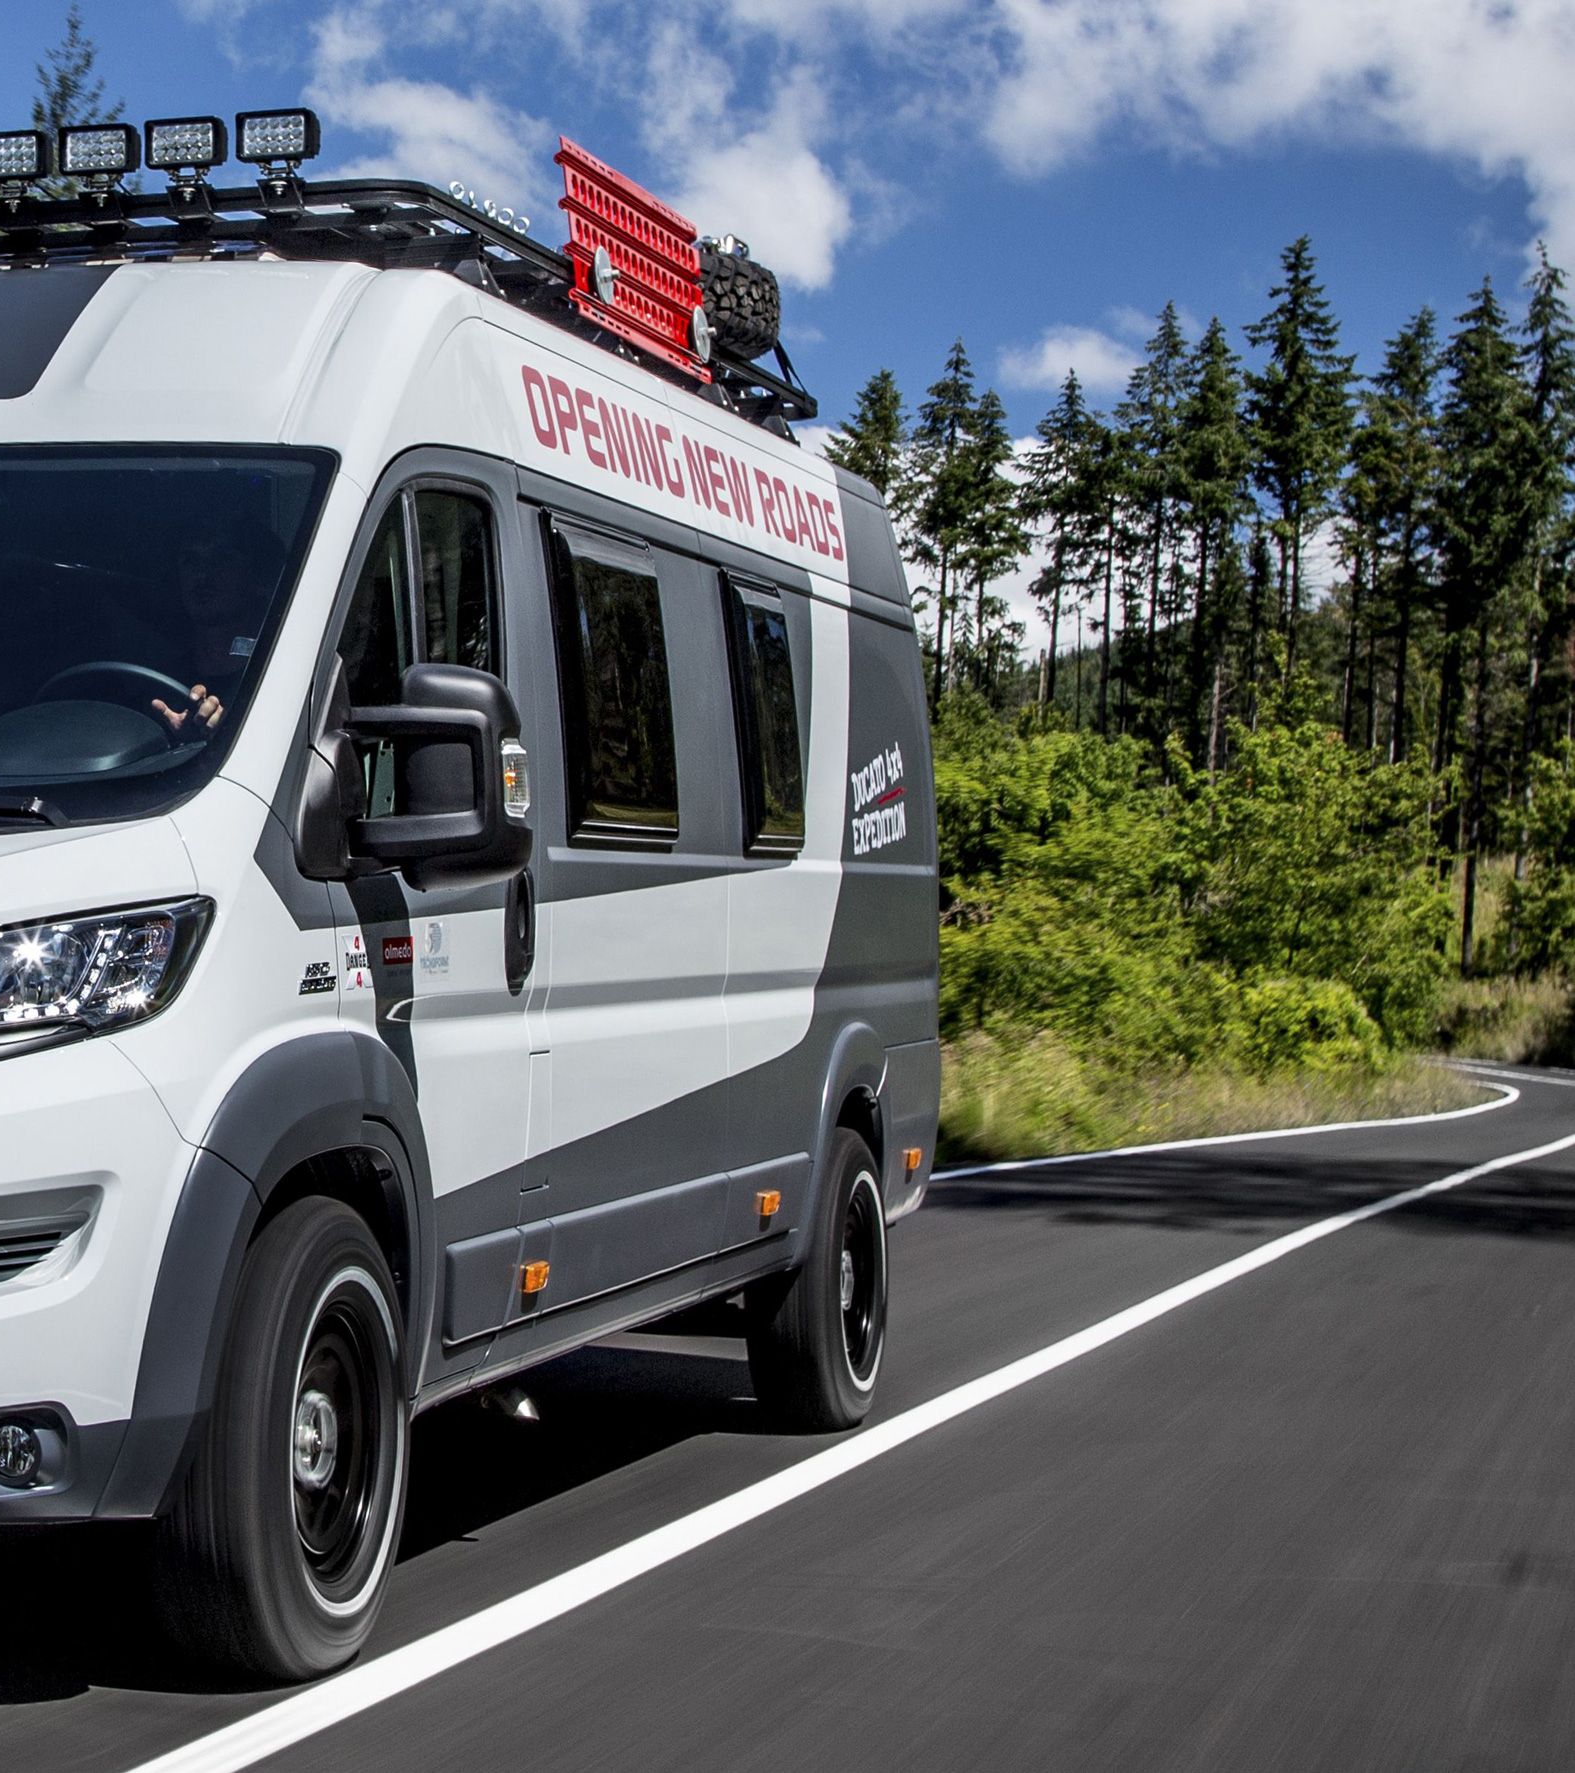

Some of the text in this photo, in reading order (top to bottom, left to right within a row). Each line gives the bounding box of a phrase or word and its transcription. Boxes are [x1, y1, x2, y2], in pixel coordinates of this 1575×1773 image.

[521, 364, 844, 562] OPENING NEW ROADS
[851, 754, 885, 812] DUCATO
[852, 801, 906, 855] EXPEDITION
[384, 943, 412, 959] olmedo
